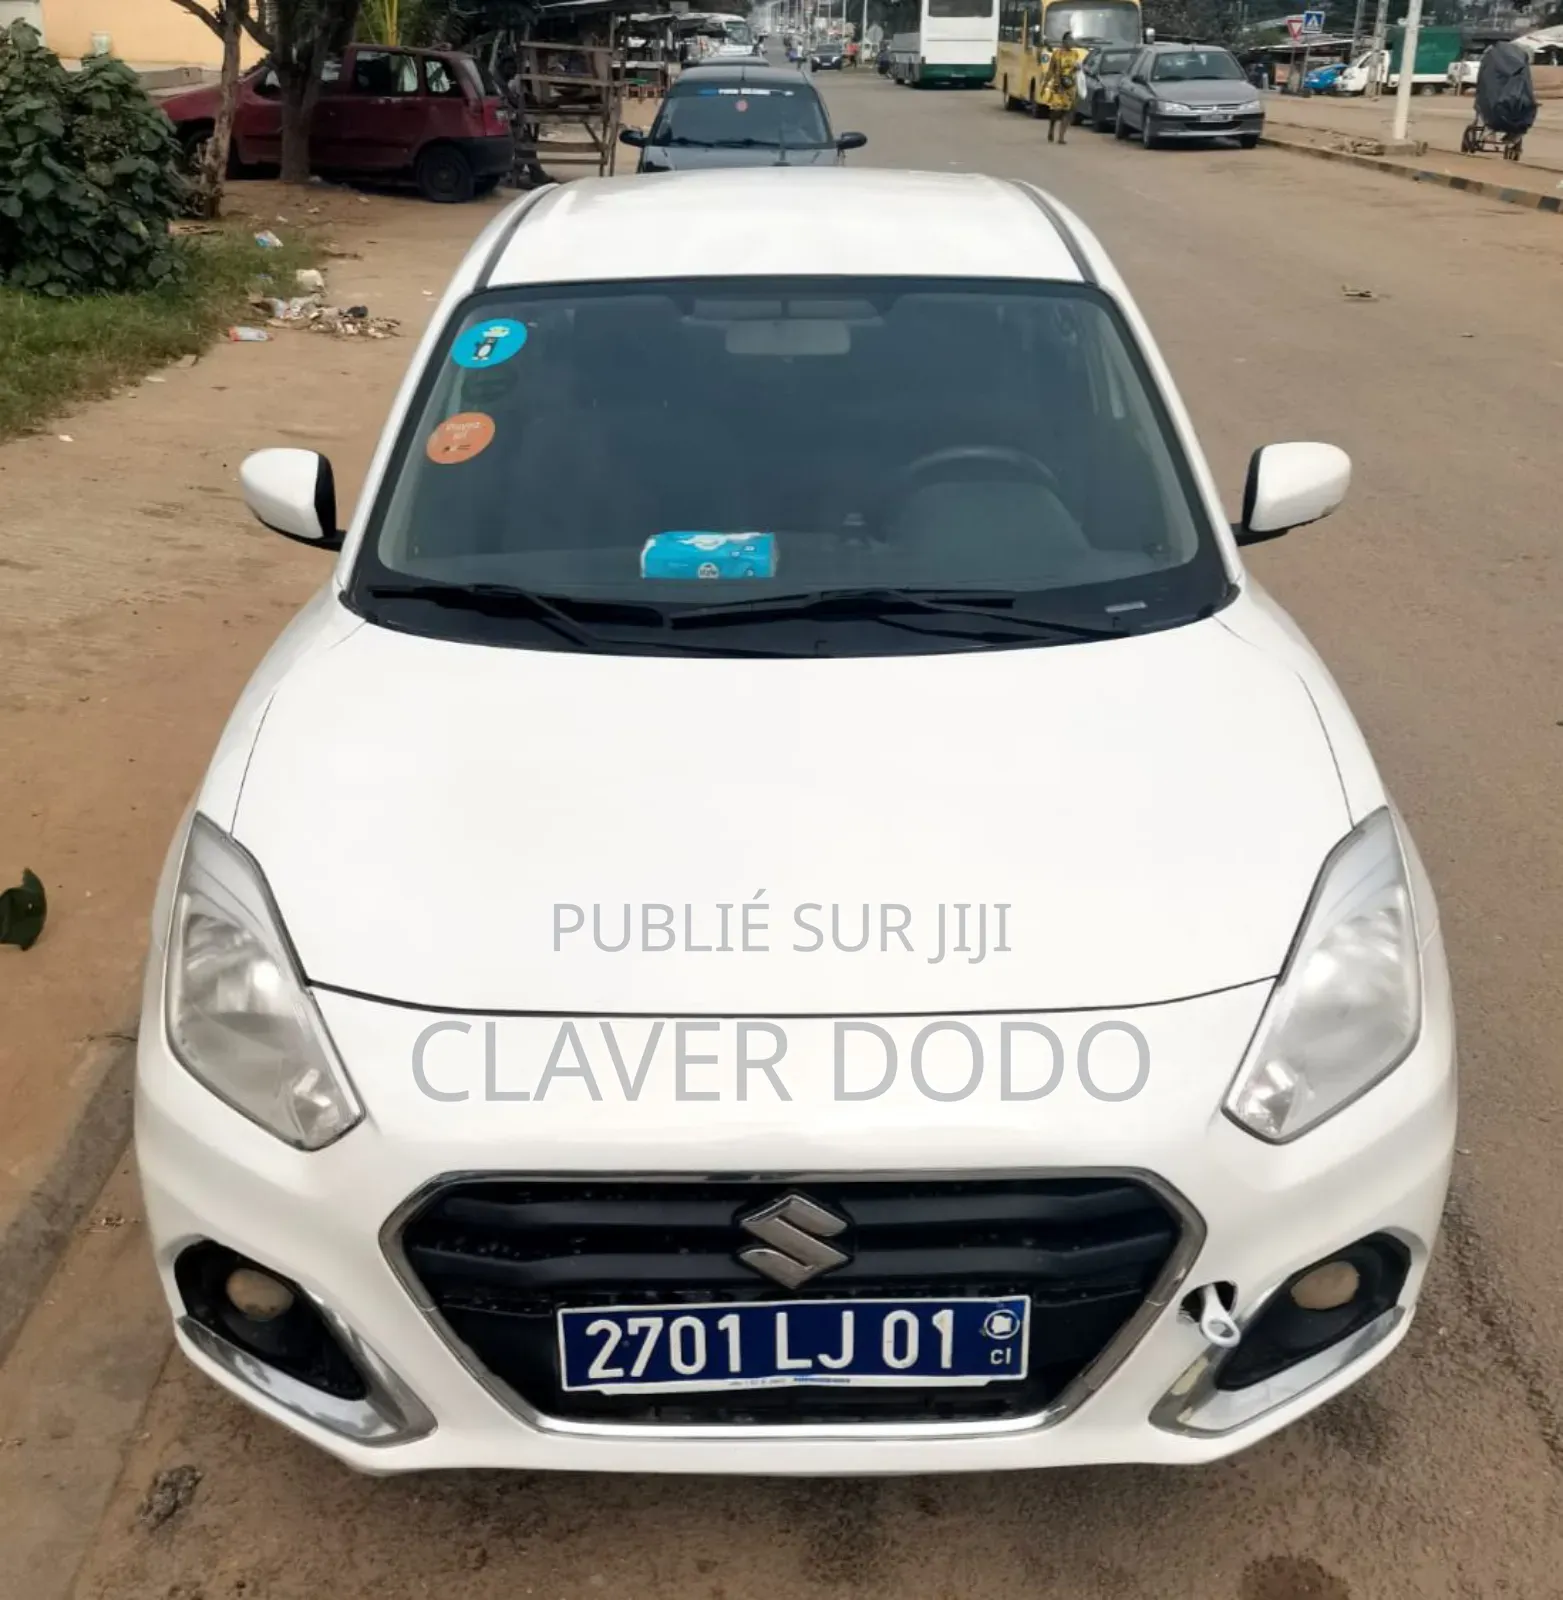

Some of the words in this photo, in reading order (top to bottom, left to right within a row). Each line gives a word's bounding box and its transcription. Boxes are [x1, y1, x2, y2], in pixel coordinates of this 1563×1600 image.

[585, 1313, 741, 1379] 2701
[776, 1310, 854, 1370] LJ
[882, 1308, 954, 1369] 01
